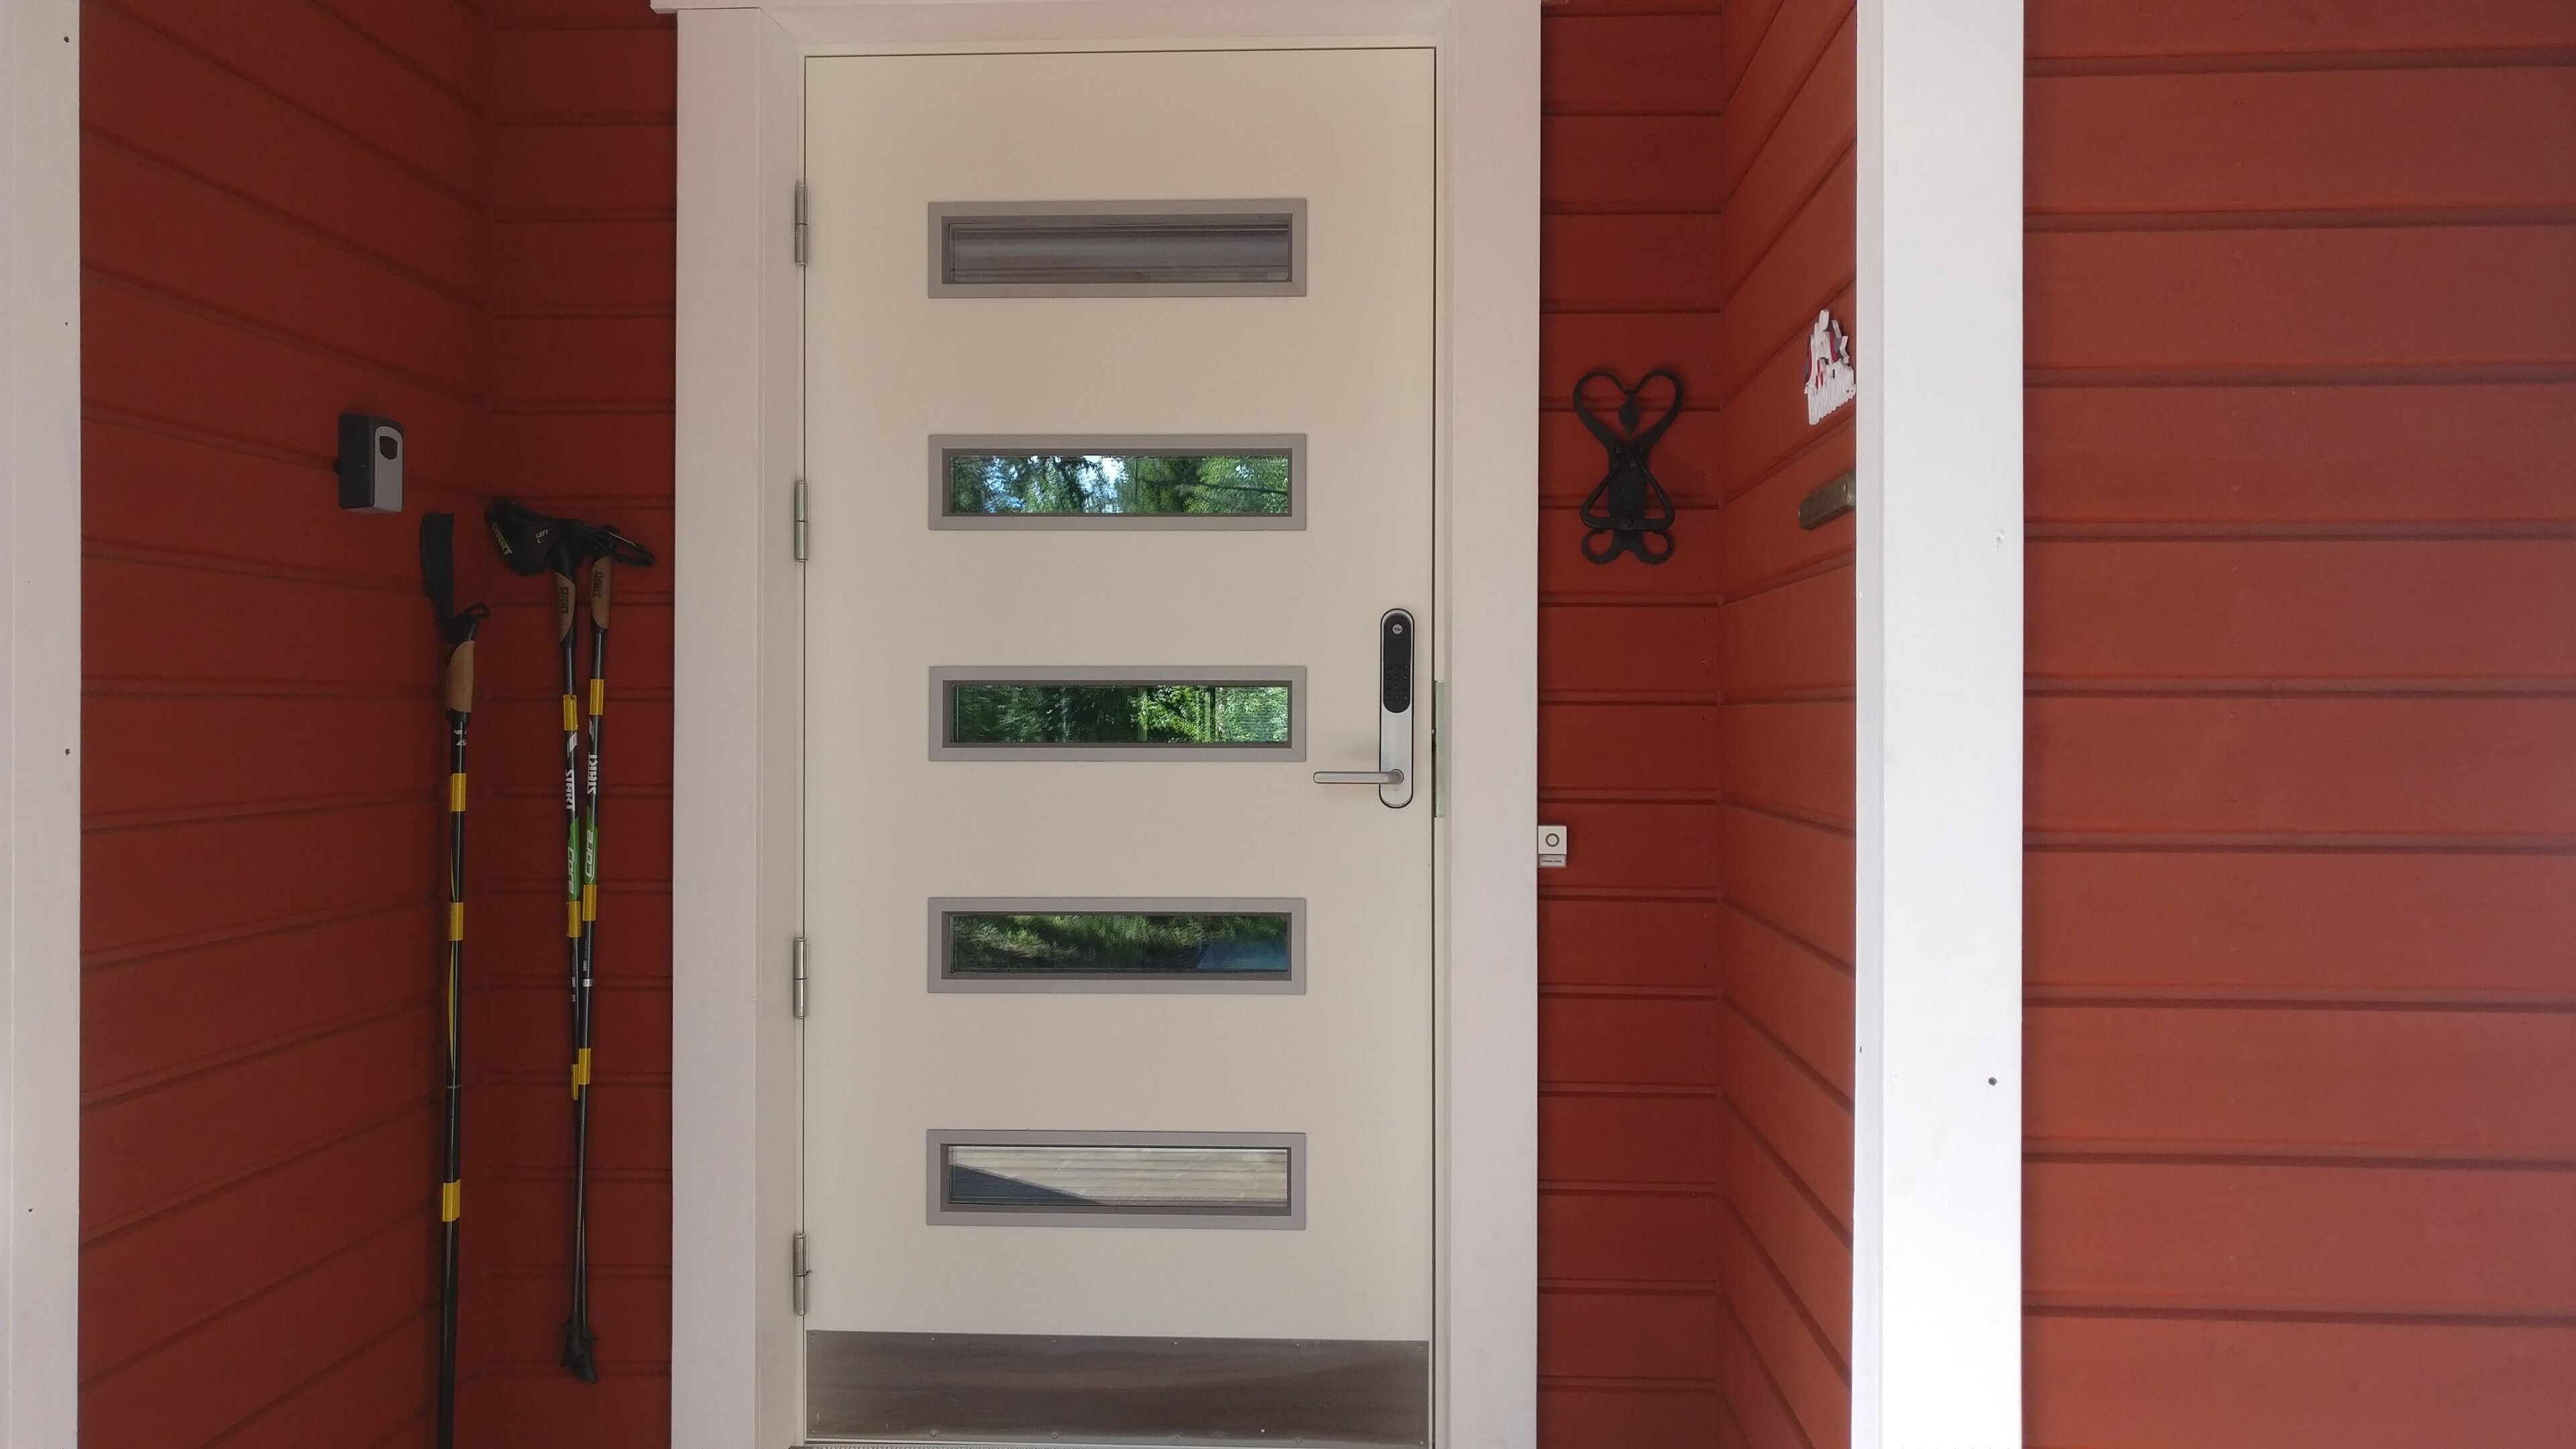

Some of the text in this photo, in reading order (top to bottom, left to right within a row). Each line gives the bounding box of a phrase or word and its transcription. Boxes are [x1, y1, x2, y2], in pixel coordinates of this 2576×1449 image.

[536, 529, 549, 539] LEFT
[566, 768, 576, 894] START Core
[584, 751, 598, 877] Core START
